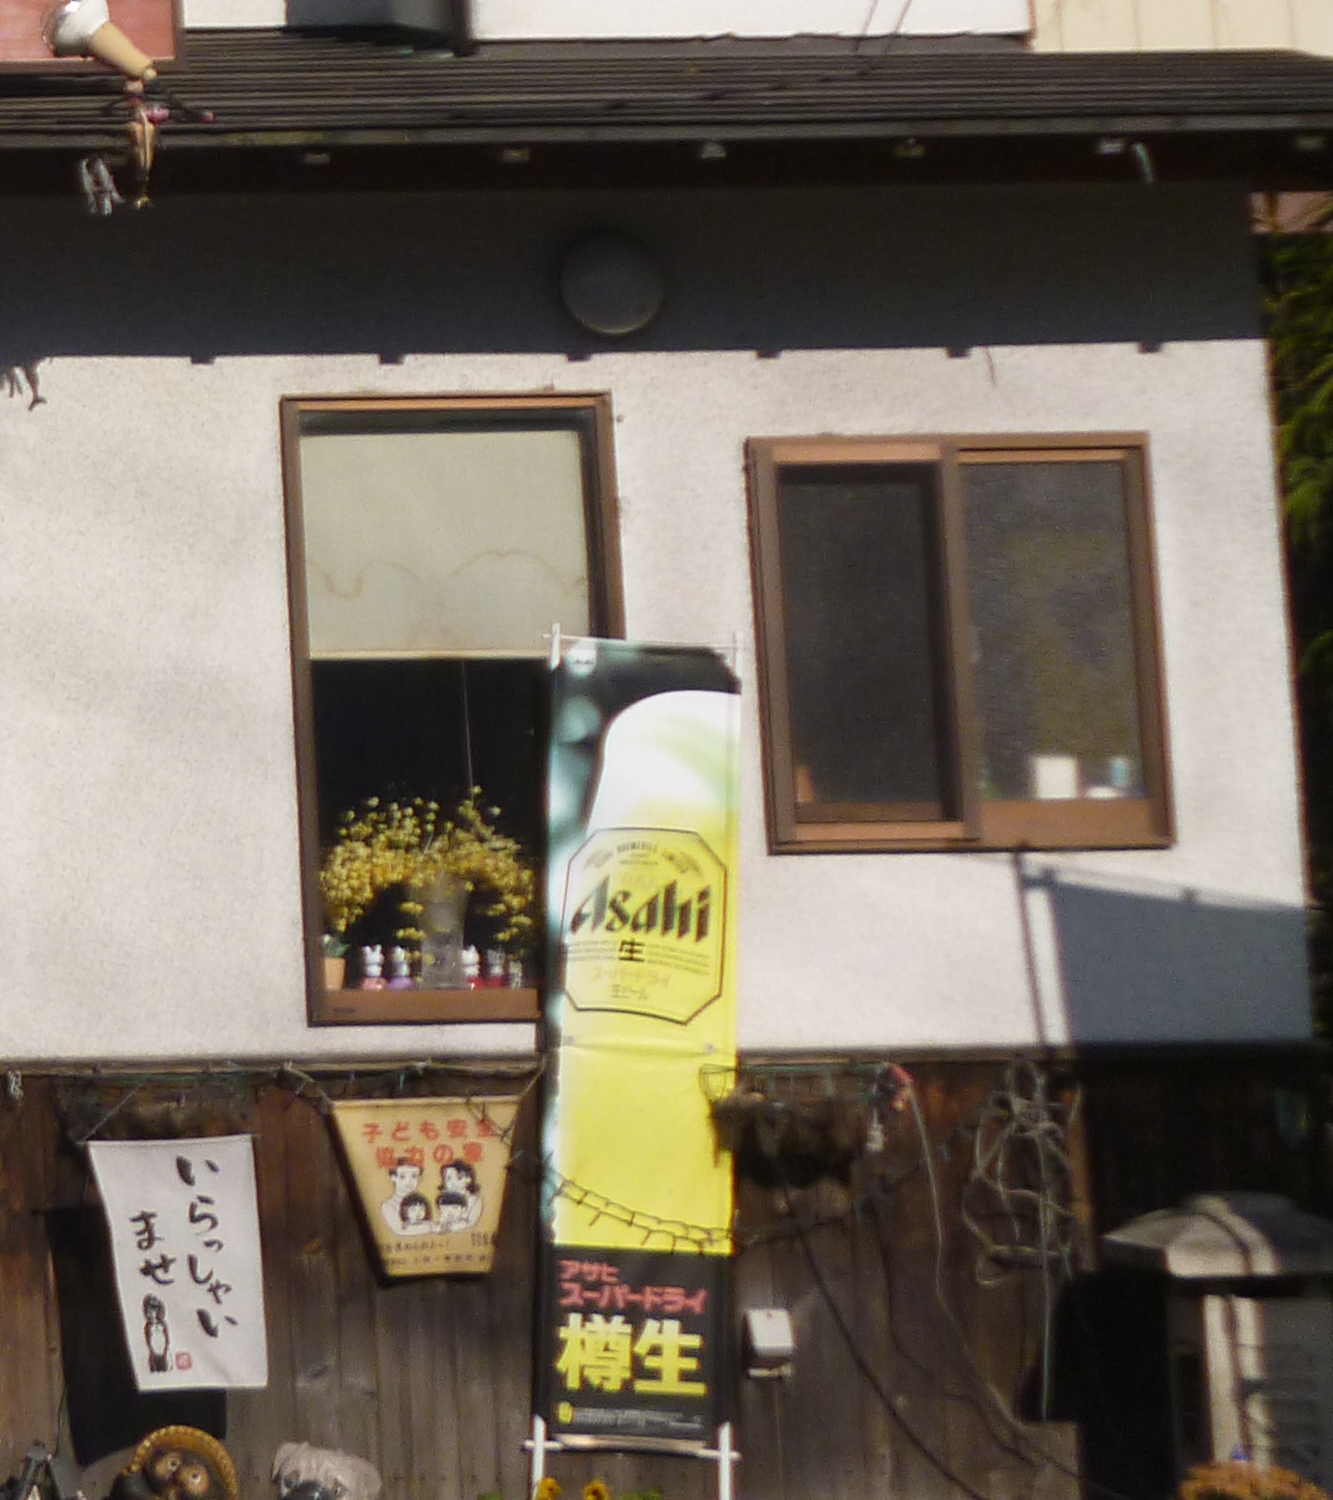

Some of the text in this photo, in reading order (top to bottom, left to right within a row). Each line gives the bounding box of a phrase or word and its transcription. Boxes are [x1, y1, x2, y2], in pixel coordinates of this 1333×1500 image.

[570, 874, 712, 942] Asahi
[129, 1210, 176, 1287] ませ
[176, 1155, 238, 1338] いらっしゃい
[558, 1282, 709, 1314] スーパードライ
[557, 1312, 708, 1397] 樽生
